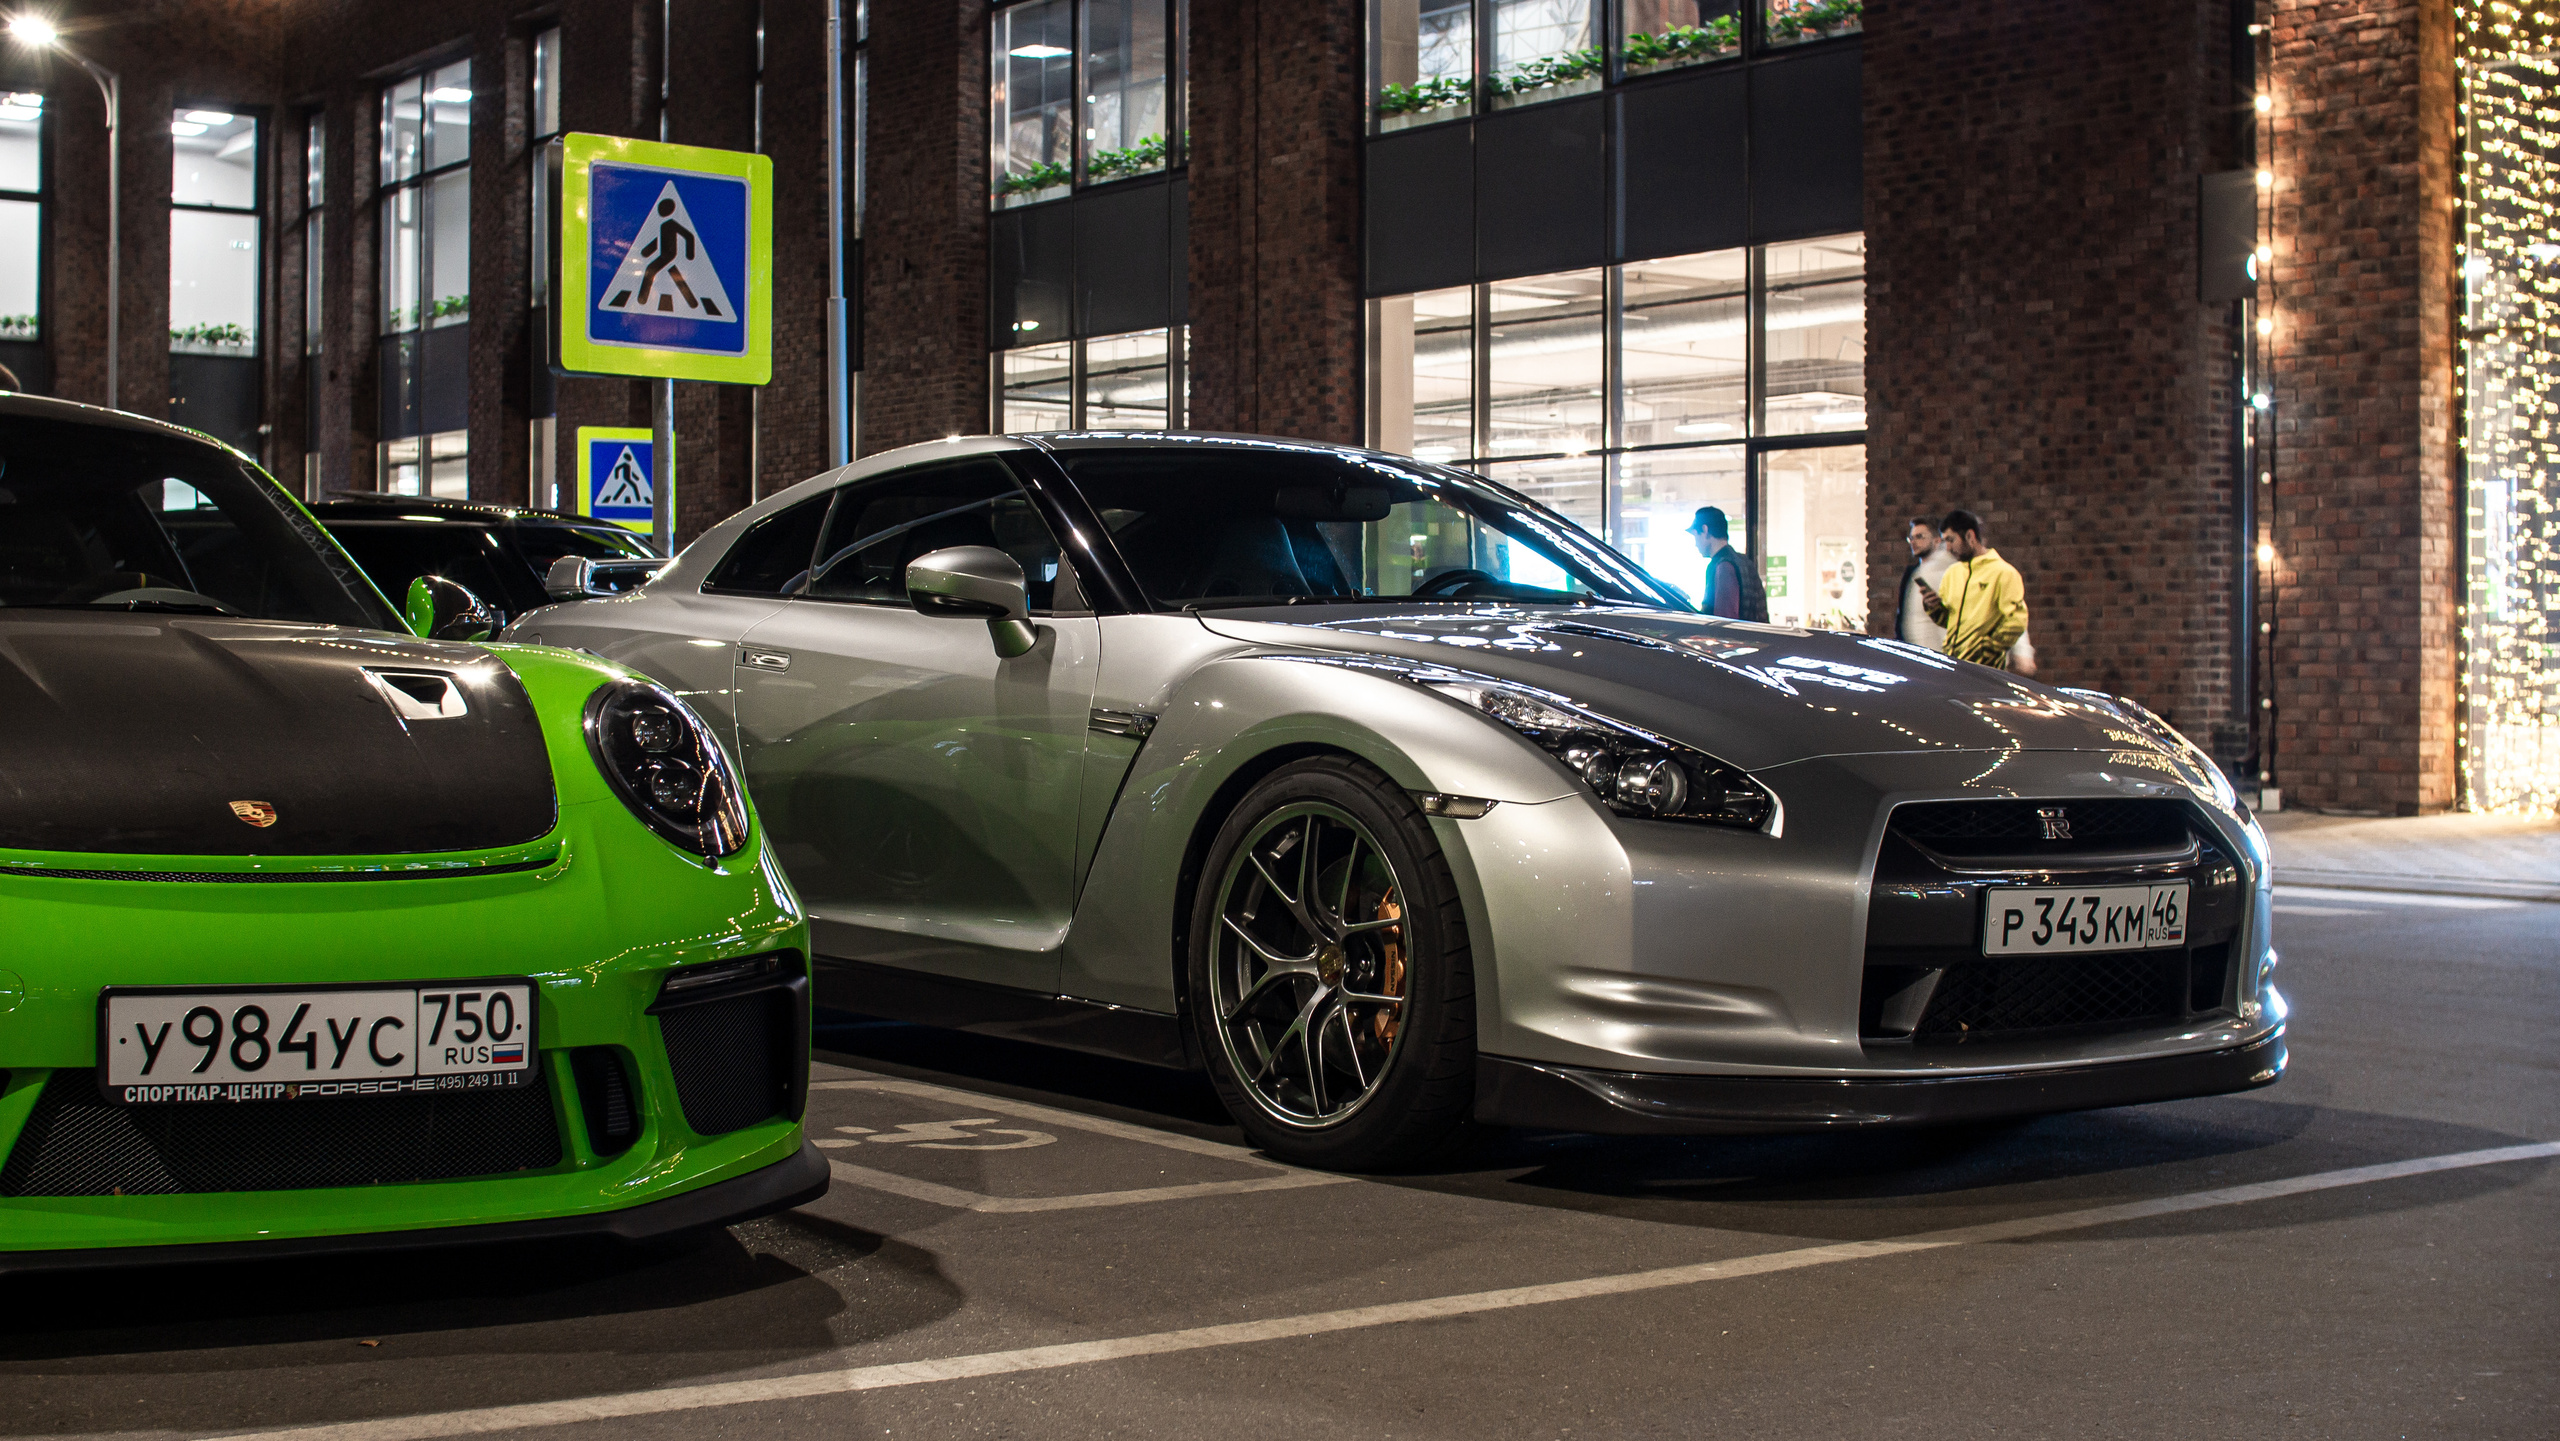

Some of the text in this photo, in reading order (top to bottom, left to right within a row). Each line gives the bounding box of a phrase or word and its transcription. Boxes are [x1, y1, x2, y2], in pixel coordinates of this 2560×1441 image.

[2151, 889, 2178, 926] 46
[2148, 927, 2168, 941] RUS
[135, 991, 514, 1075] У984УС 750
[445, 1046, 490, 1065] RUS
[124, 1083, 286, 1103] СПОРТКАР-ЦЕНТР
[299, 1072, 518, 1096] PORSCHE (495) 249 11 11
